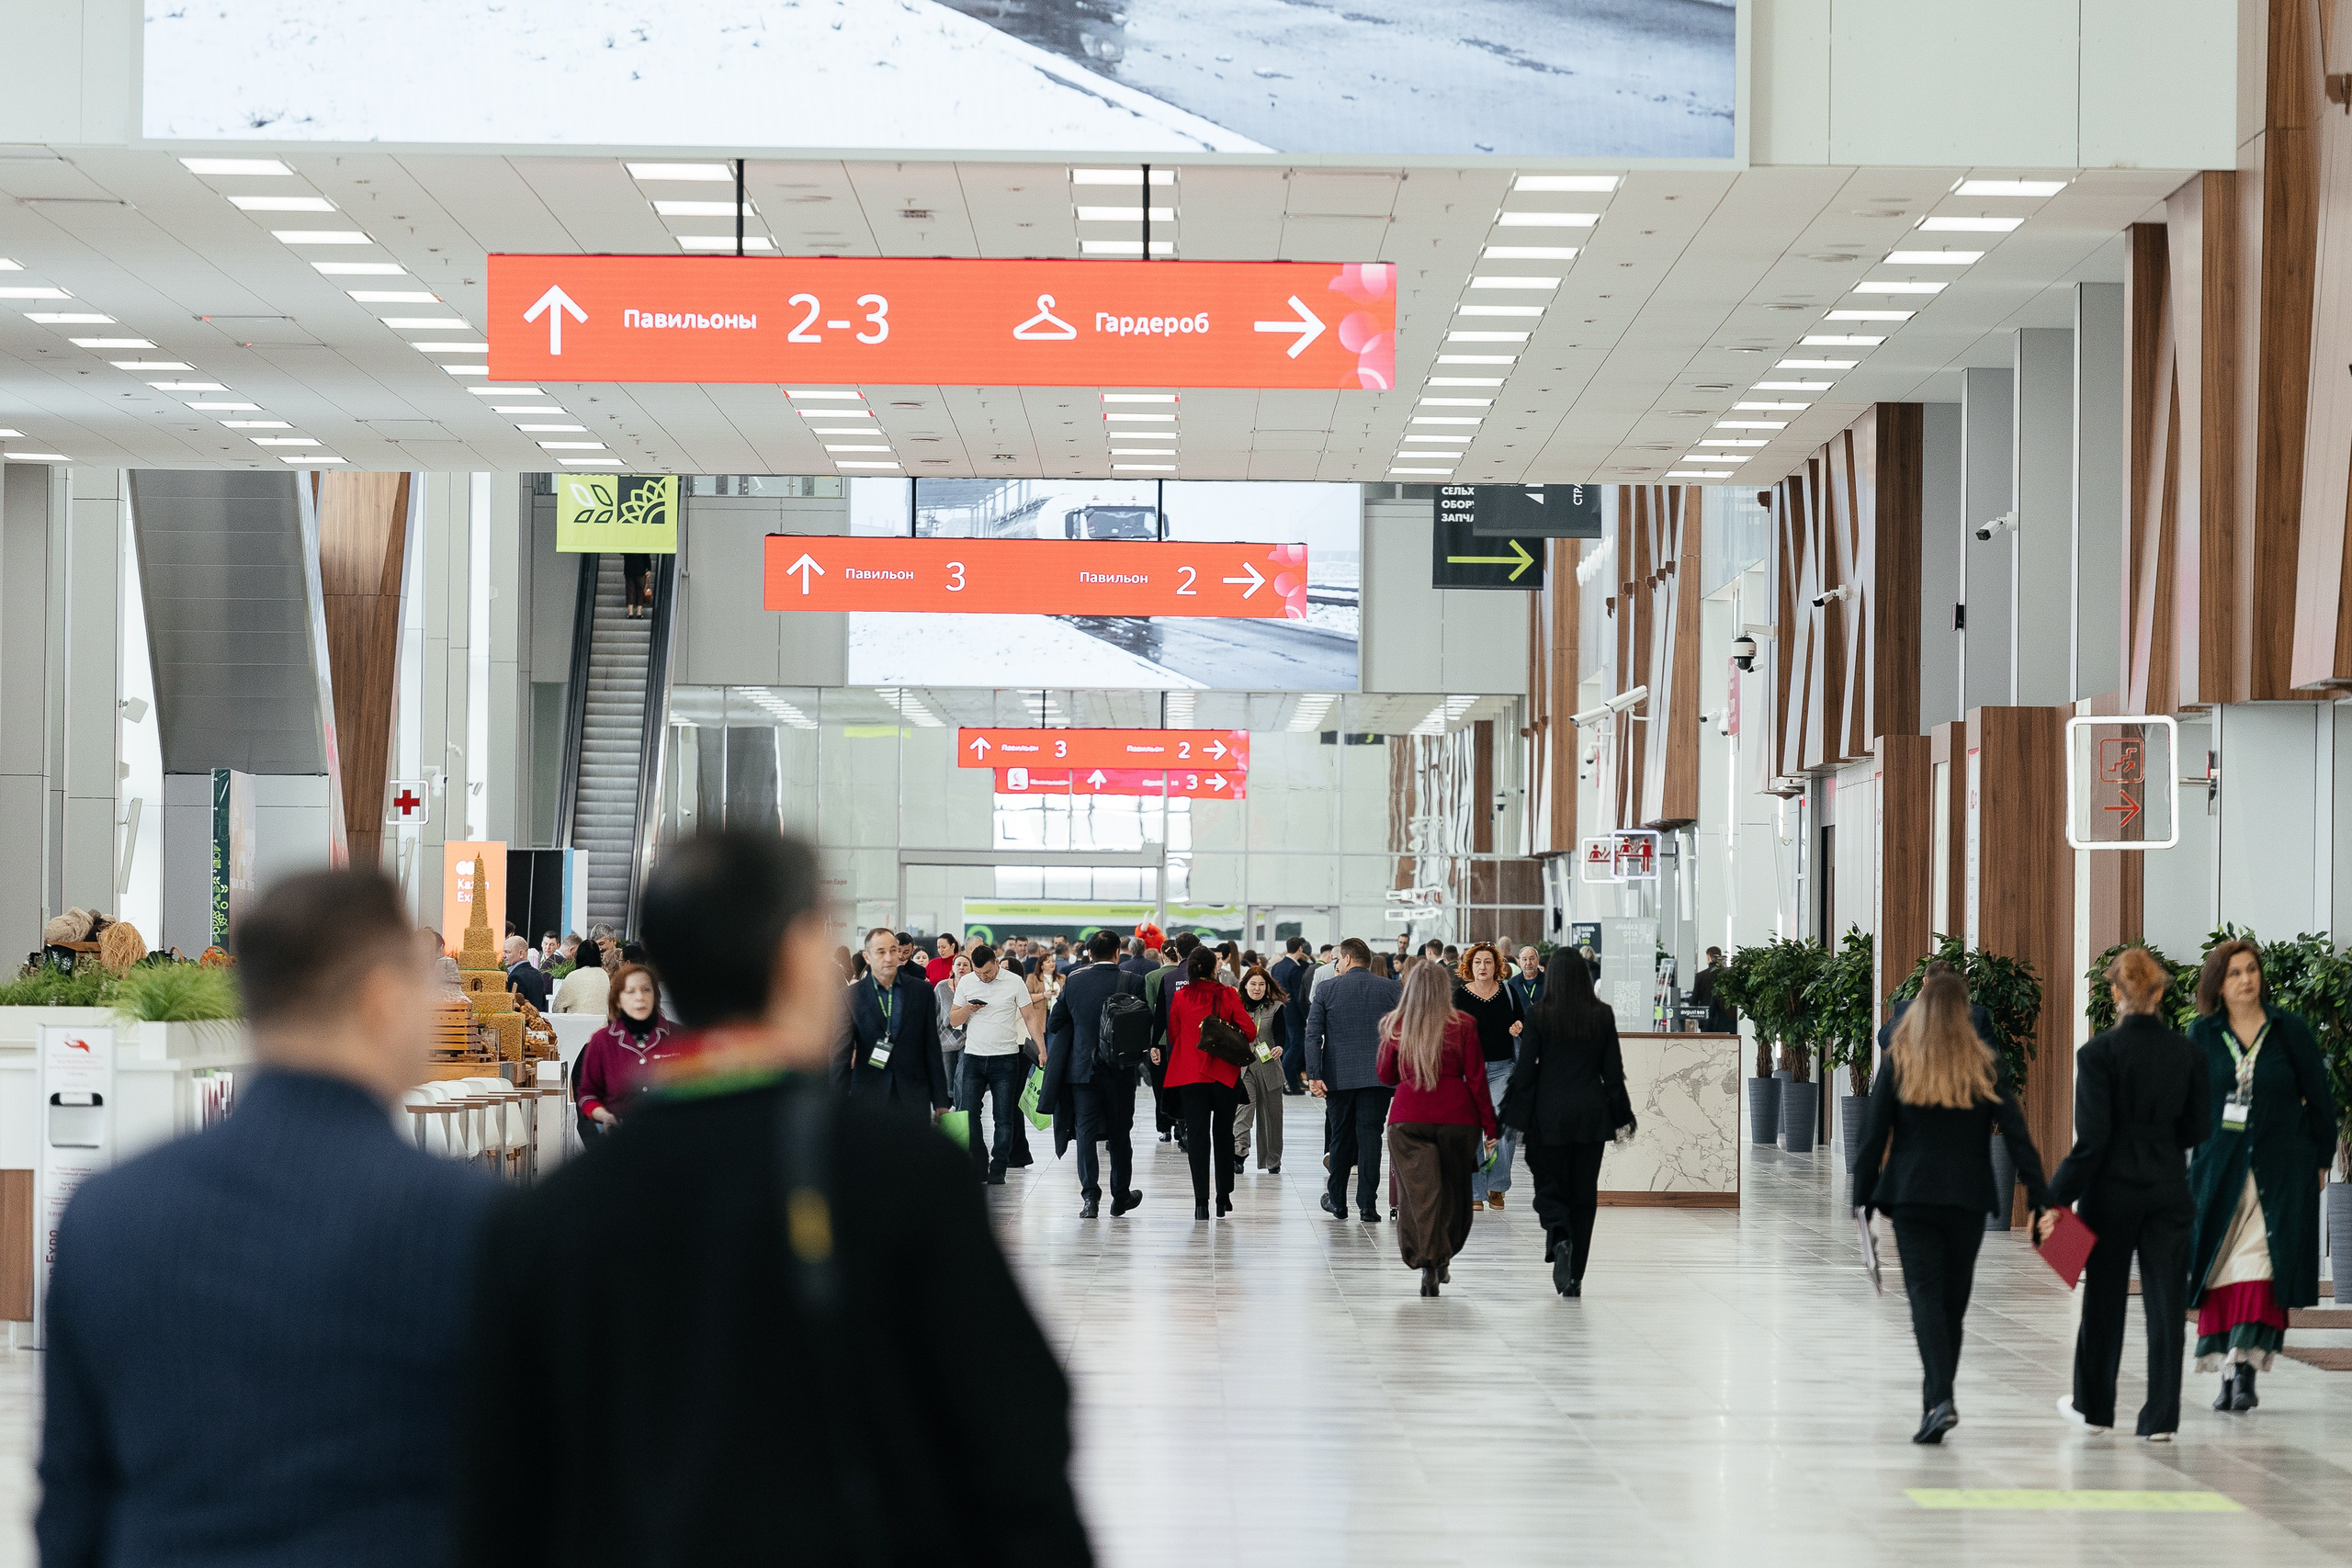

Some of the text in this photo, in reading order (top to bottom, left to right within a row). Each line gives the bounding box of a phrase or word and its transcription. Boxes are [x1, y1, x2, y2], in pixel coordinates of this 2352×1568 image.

[624, 293, 889, 344] Павильоны 2-3
[1095, 311, 1210, 336] Гардероб
[845, 561, 966, 592] Павильон 3
[1080, 566, 1197, 595] Павильон 2
[1055, 739, 1068, 758] 3
[1178, 741, 1191, 759] 2
[1186, 773, 1198, 790] 3
[458, 878, 490, 890] Kazn
